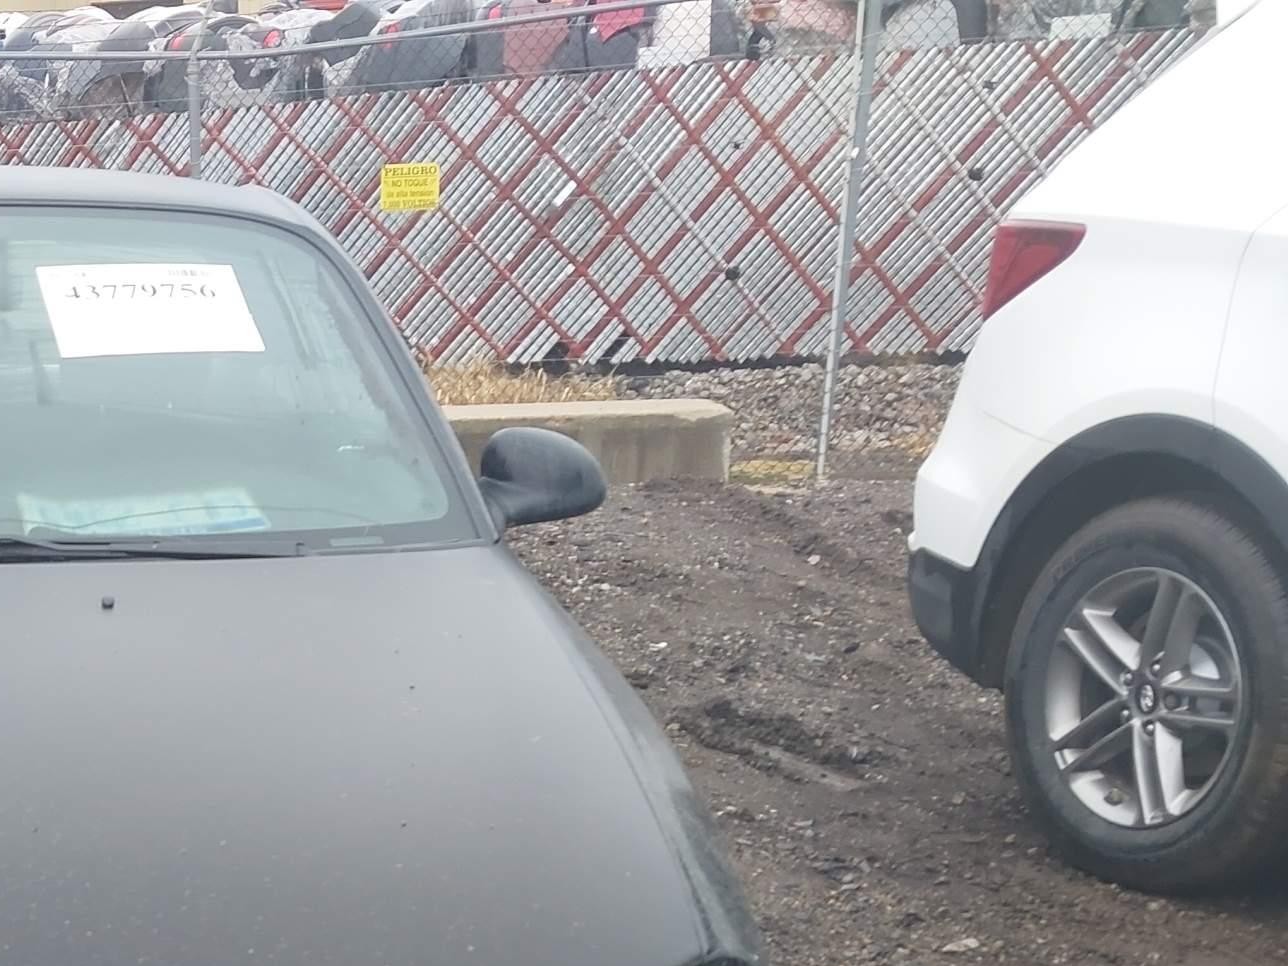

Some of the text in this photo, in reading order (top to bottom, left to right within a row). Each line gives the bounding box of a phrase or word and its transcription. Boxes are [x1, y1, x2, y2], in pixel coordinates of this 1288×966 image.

[384, 166, 437, 176] PELIGRO
[392, 179, 402, 187] NO
[64, 284, 216, 299] 43779756
